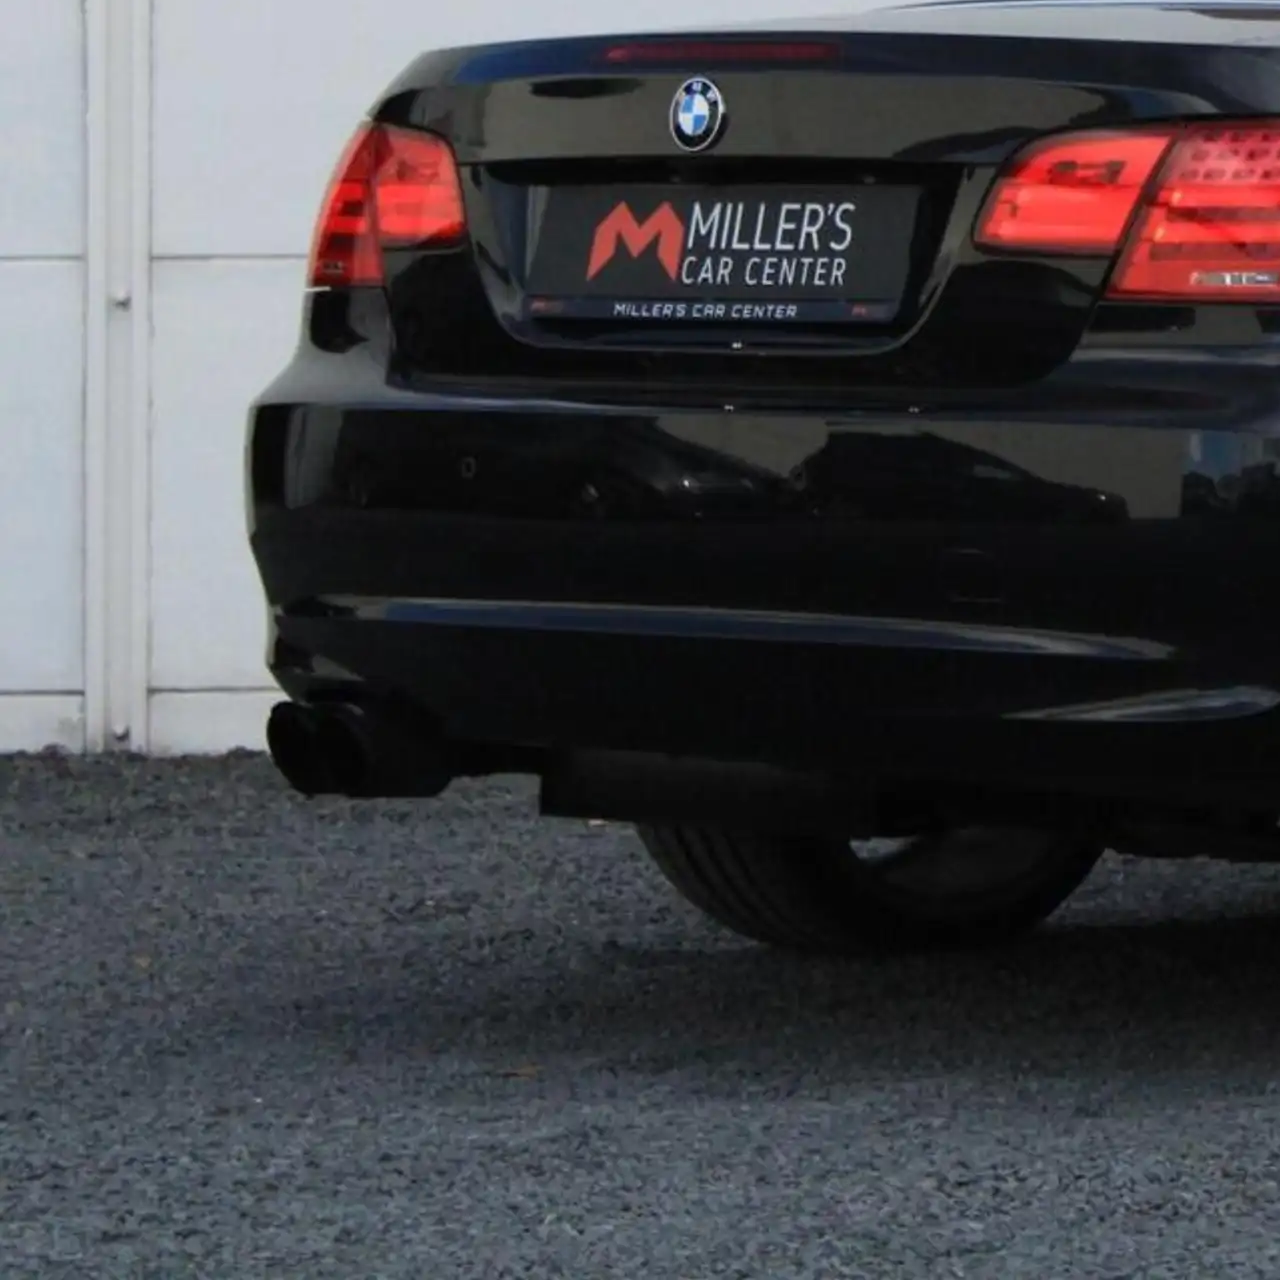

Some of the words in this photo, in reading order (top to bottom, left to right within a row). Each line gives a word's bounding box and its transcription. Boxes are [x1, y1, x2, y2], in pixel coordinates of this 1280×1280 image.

[686, 200, 857, 252] MILLER'S
[680, 255, 732, 286] CAR
[743, 256, 847, 287] CENTER
[612, 302, 688, 318] MILLERS
[692, 303, 727, 319] CAR
[730, 303, 798, 320] CENTER
